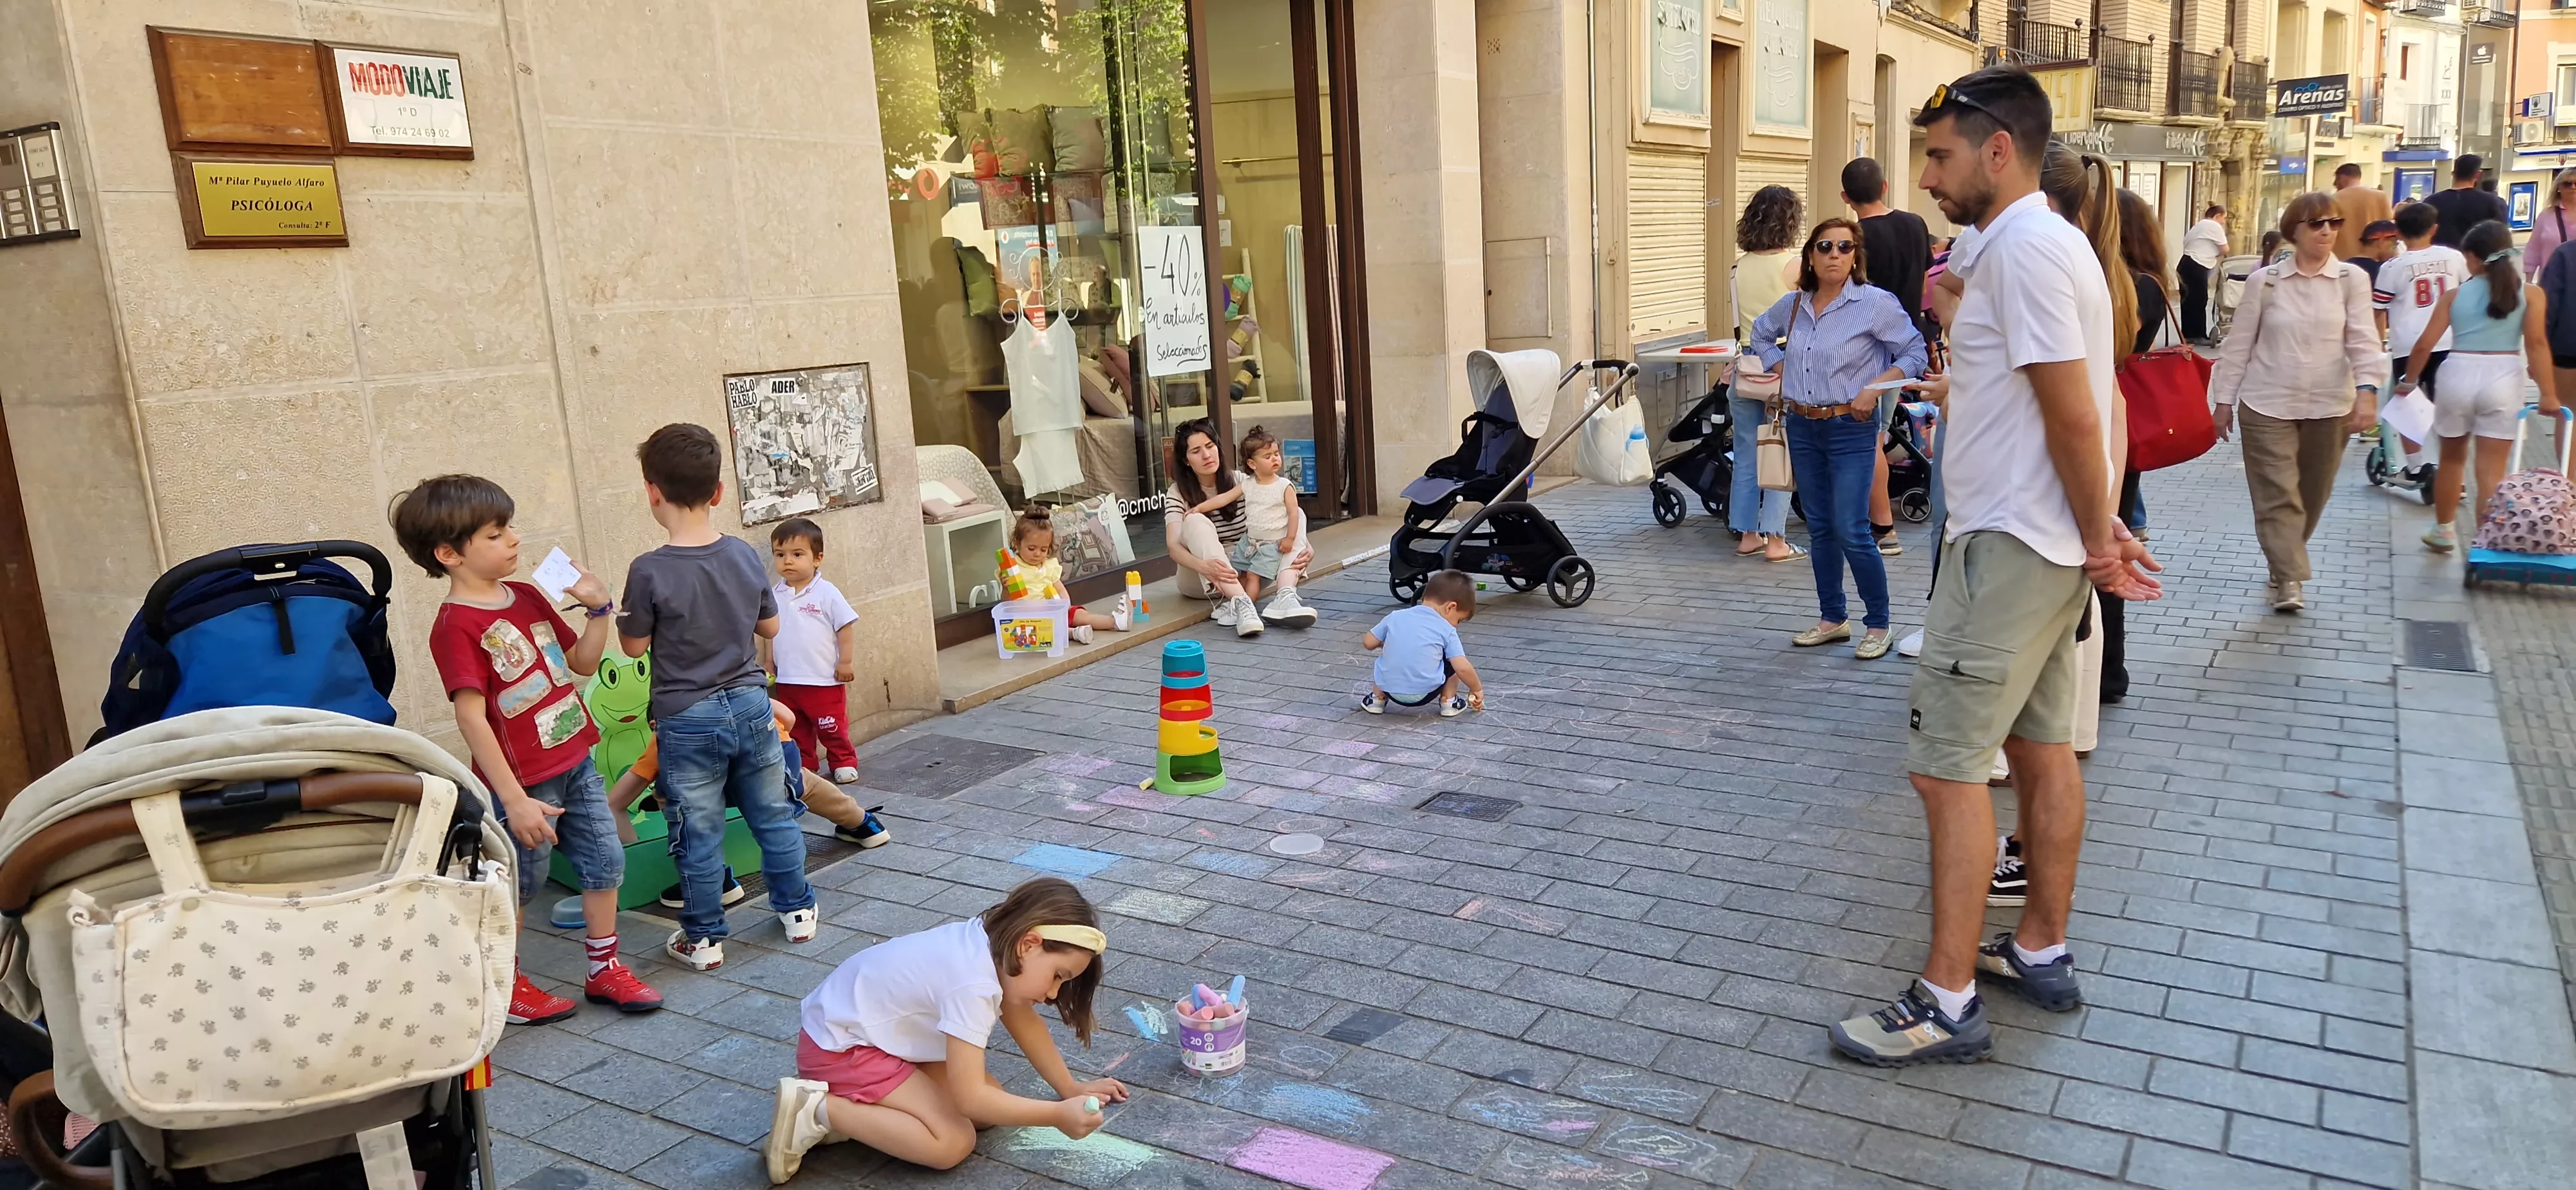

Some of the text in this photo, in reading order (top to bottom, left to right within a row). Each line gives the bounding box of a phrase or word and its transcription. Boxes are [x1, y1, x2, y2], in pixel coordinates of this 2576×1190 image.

[348, 61, 454, 100] MODOVIAJE
[2278, 89, 2345, 106] Arenas
[410, 108, 417, 117] D
[370, 126, 450, 138] Tel. 974 24 69 02
[226, 176, 251, 186] Pilar
[253, 177, 292, 188] Puyuelo
[295, 178, 325, 189] Alfaro
[231, 197, 314, 211] PSICÓLOGA
[1144, 234, 1202, 297] -40%
[2415, 275, 2447, 308] 81
[1146, 297, 1161, 330] En
[728, 379, 755, 395] PABLO
[771, 380, 795, 394] ADER
[731, 392, 758, 409] HABLO
[1189, 1037, 1202, 1046] 20
